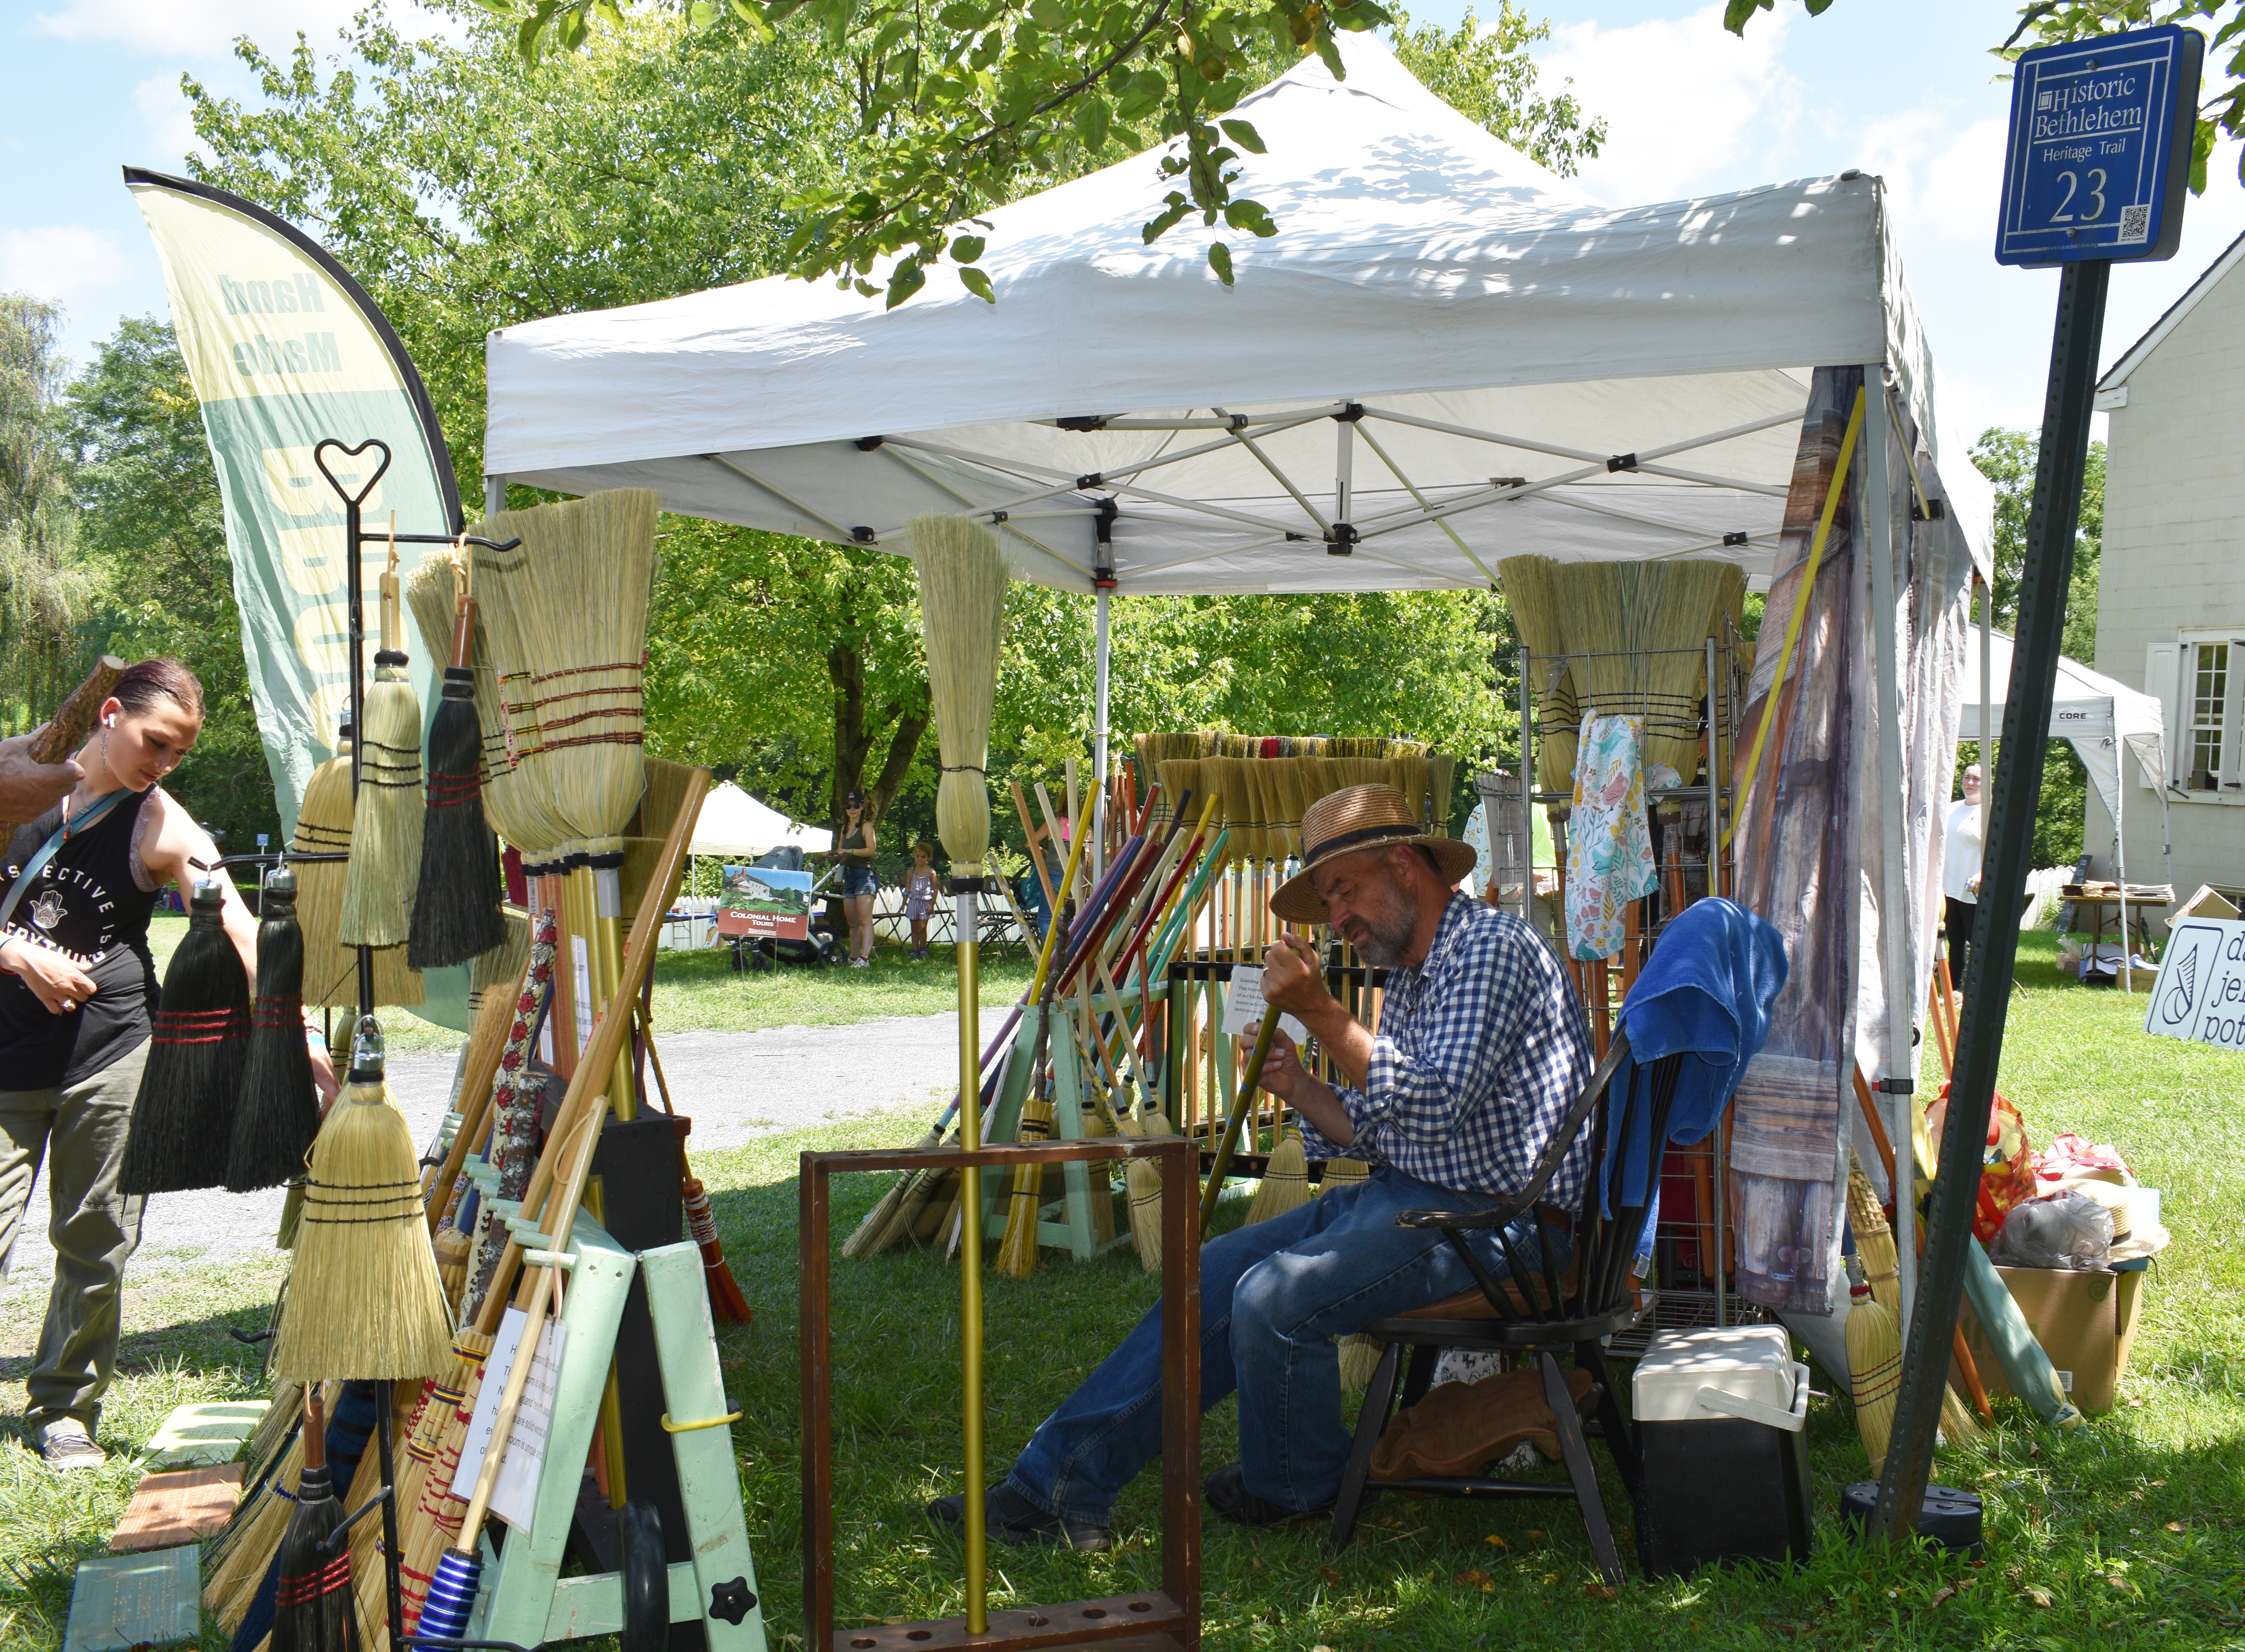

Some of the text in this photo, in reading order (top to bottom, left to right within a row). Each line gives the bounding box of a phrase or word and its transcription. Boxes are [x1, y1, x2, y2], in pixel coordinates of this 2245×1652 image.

[2052, 73, 2135, 112] Historic
[2034, 105, 2142, 138] Bethlehem
[2043, 137, 2126, 162] Heritage Trail
[2049, 168, 2107, 223] 23
[0, 865, 114, 913] SECTIVE
[100, 924, 114, 944] IS
[730, 911, 796, 923] COLONIAL HOME
[2227, 931, 2245, 962] d
[2211, 971, 2245, 1008] je
[524, 1375, 535, 1385] oom
[519, 1394, 532, 1408] gland
[516, 1416, 525, 1427] are
[526, 1420, 535, 1431] solid
[507, 1435, 520, 1446] room
